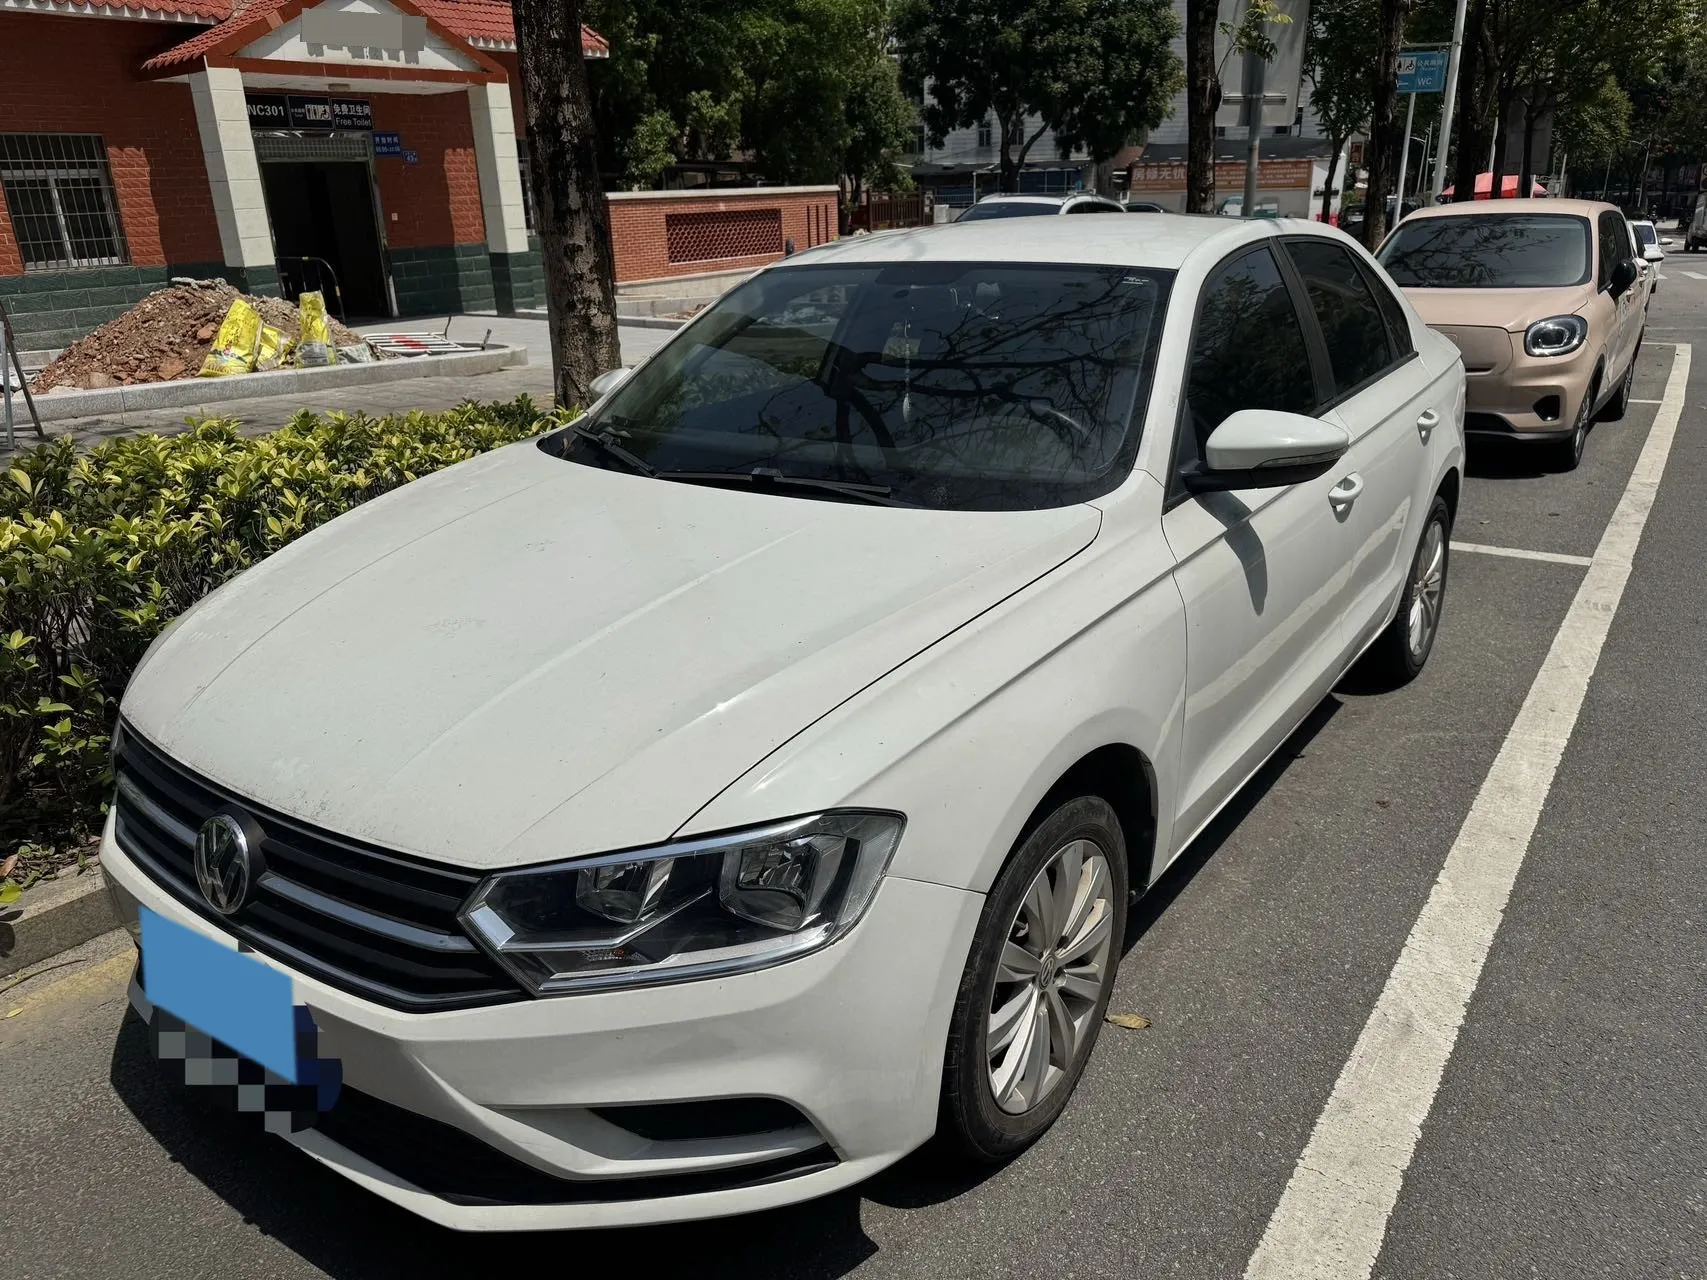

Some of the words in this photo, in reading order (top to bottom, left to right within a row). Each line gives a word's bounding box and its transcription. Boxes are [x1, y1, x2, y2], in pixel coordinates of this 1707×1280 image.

[1417, 78, 1432, 87] WC
[247, 104, 285, 117] NC301
[333, 103, 371, 116] 免费卫生间
[336, 118, 351, 126] Free
[353, 118, 371, 127] Toilet
